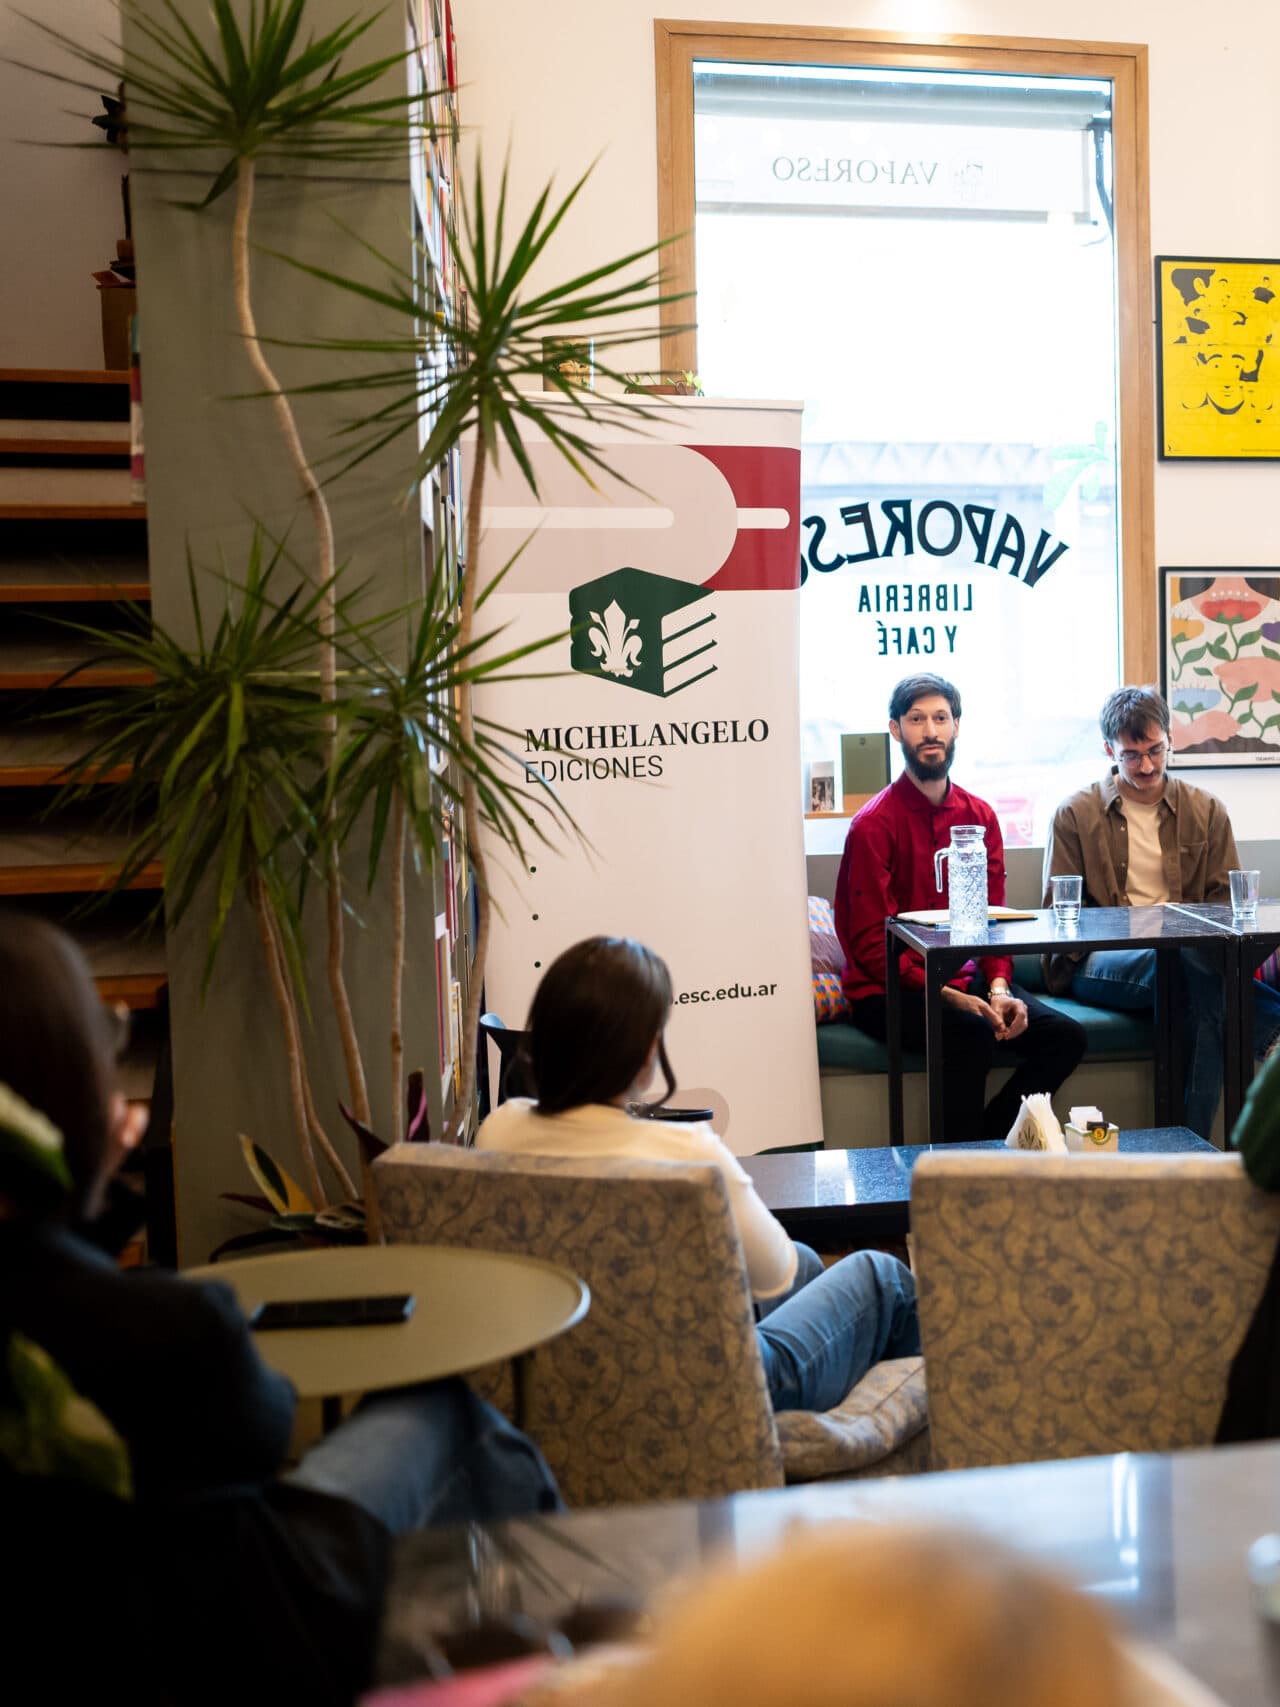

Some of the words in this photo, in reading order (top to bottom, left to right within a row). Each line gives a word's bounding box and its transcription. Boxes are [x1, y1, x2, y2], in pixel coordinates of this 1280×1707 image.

[524, 718, 769, 753] MICHELANGELO
[524, 754, 664, 784] EDICIONES
[672, 983, 778, 1005] .esc.edu.ar
